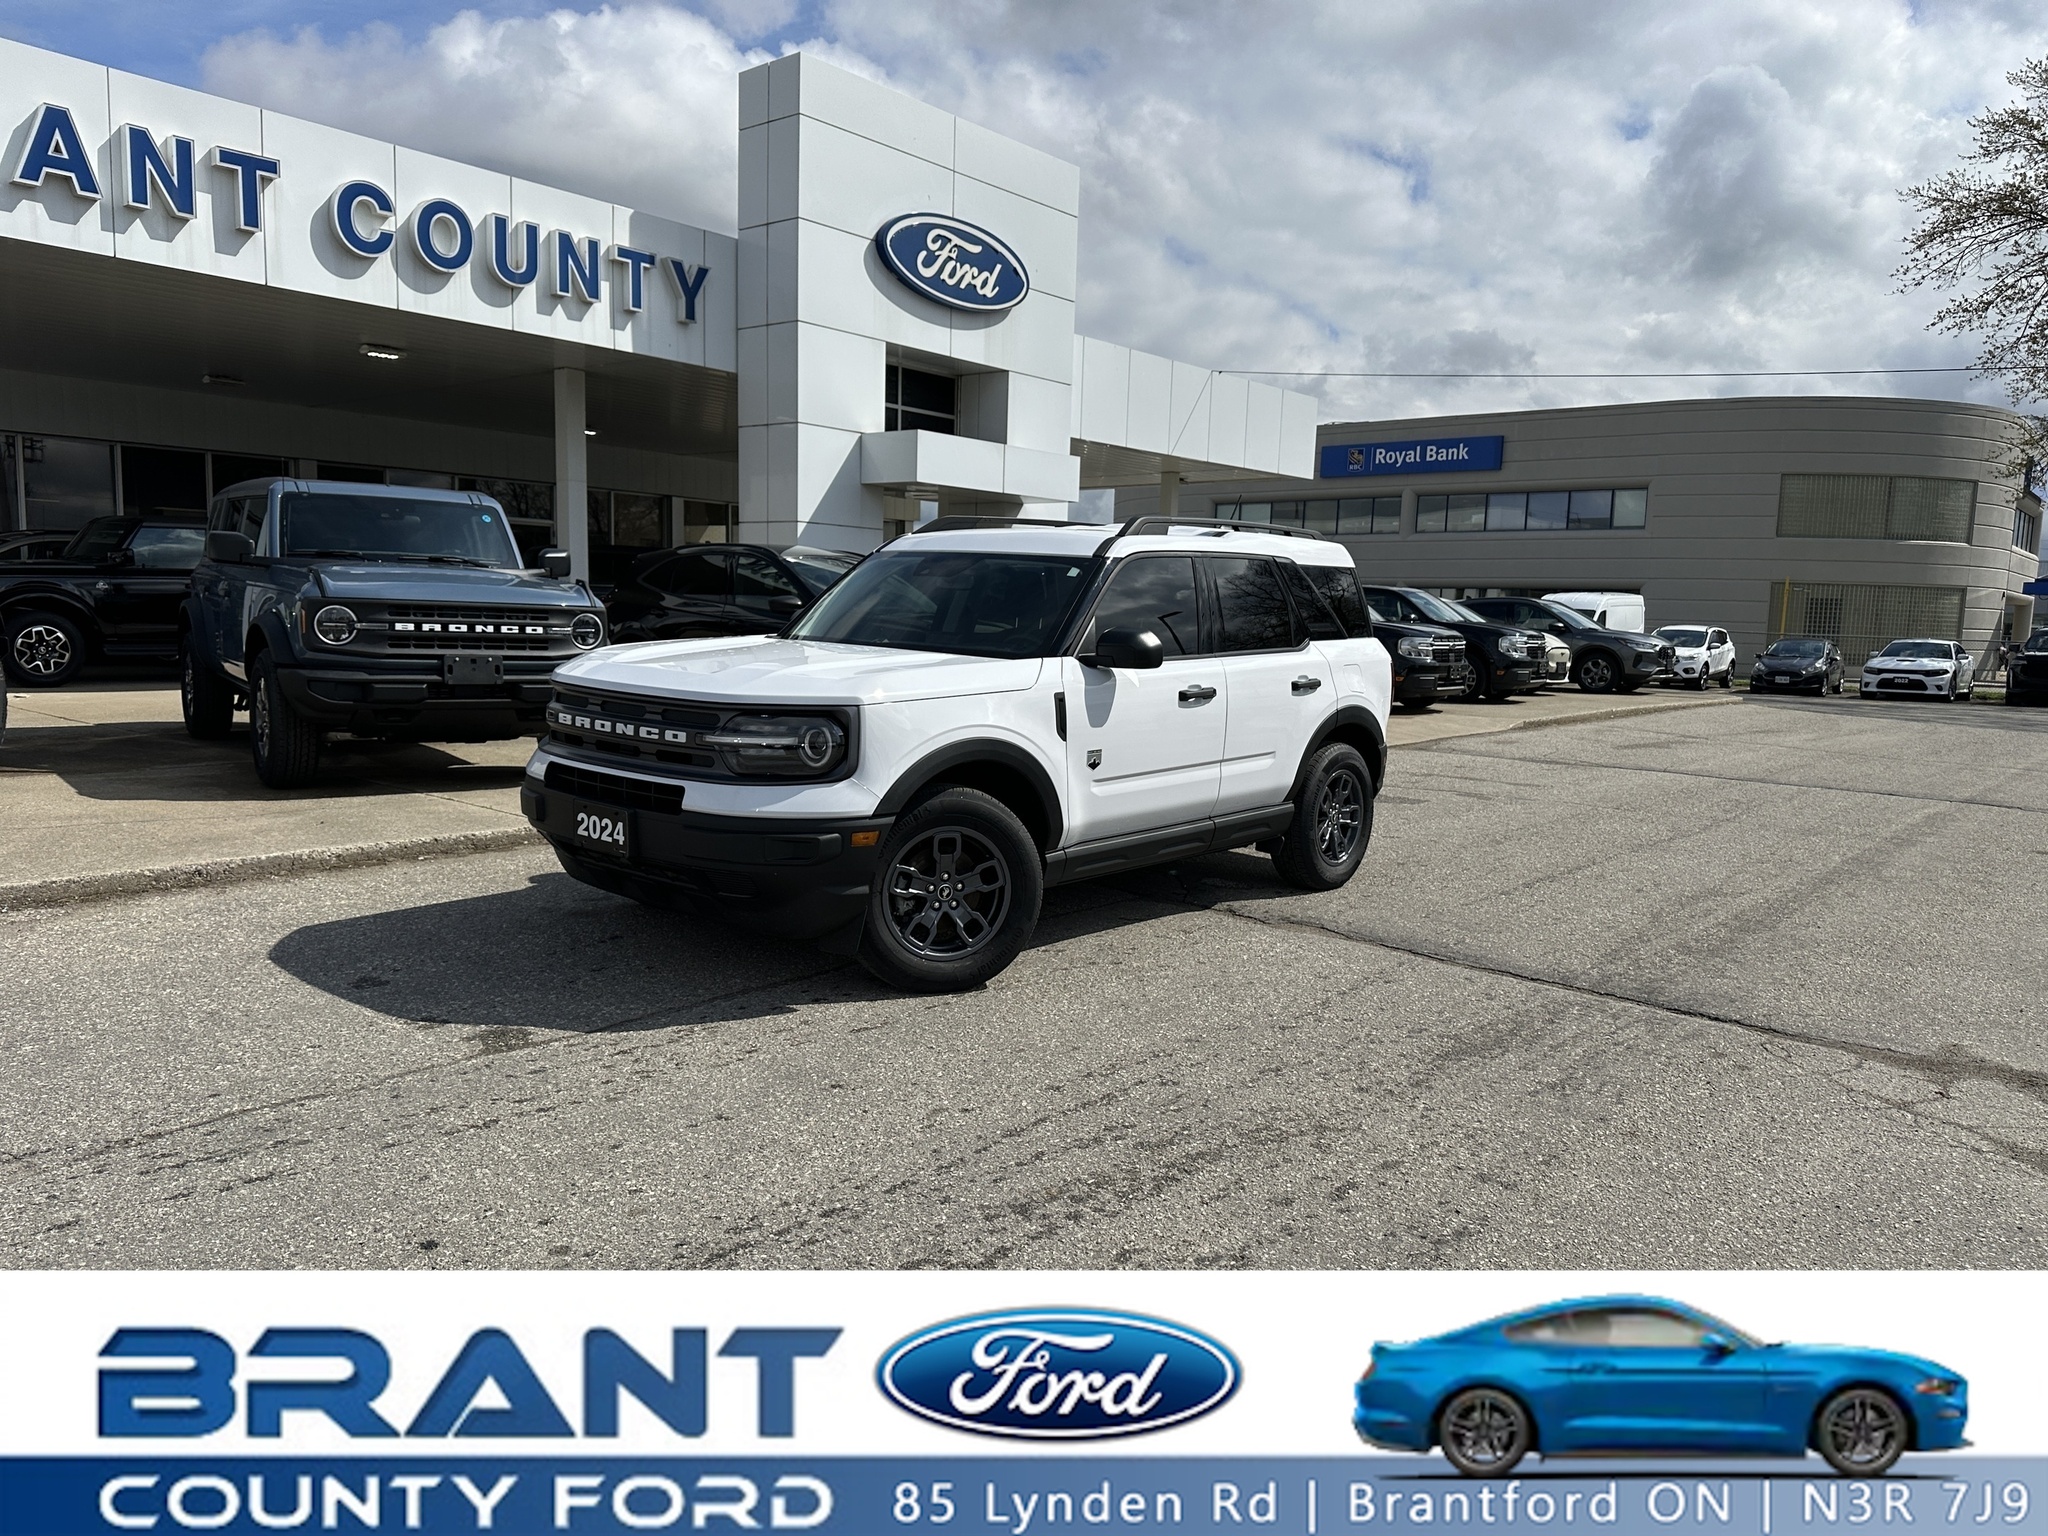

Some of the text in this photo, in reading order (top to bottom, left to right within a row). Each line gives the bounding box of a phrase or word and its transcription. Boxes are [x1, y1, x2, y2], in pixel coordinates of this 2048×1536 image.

[12, 102, 711, 325] ANT COUNTY
[916, 228, 1003, 298] Ford
[1375, 443, 1469, 467] Royal Bank
[394, 622, 544, 635] BRONCO
[558, 712, 687, 744] BRONCO
[576, 812, 625, 846] 2024
